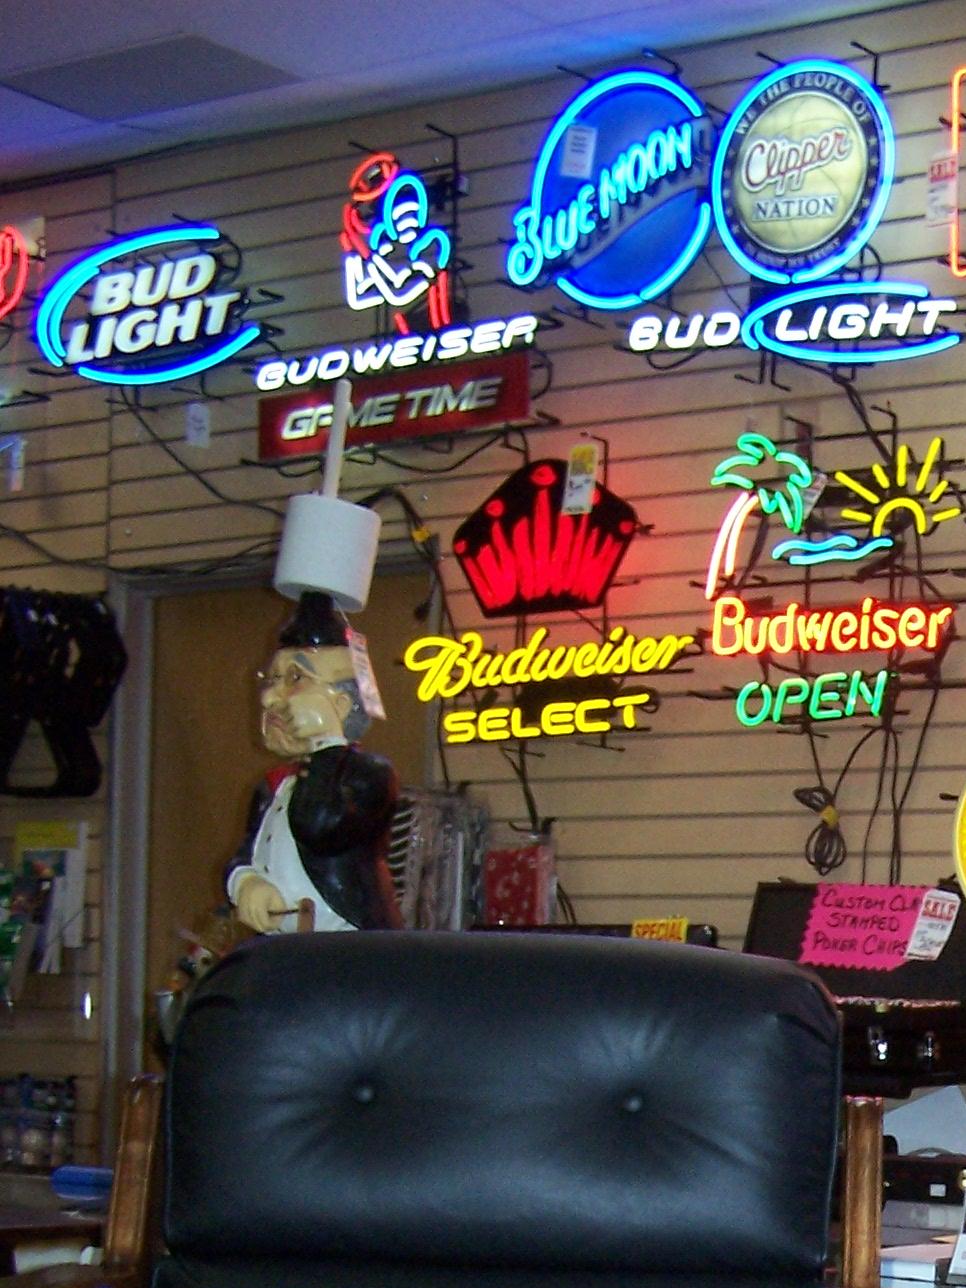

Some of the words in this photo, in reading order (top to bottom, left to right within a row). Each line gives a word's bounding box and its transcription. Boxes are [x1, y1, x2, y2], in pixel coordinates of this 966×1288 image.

[758, 77, 792, 107] THE
[793, 73, 855, 103] PEOPLE
[744, 128, 850, 194] Clipper
[507, 184, 596, 286] BLUE
[599, 121, 692, 220] MOON
[753, 197, 837, 219] NATION
[89, 254, 218, 316] BUD
[66, 292, 241, 365] LIGHT
[256, 315, 537, 391] BUDWEISER
[628, 311, 742, 352] BUD
[774, 298, 956, 343] LIGHT
[403, 376, 503, 420] TIME
[711, 596, 954, 656] Budweiser
[403, 627, 694, 702] Budweiser
[443, 693, 652, 744] SELECT
[735, 669, 890, 728] OPEN
